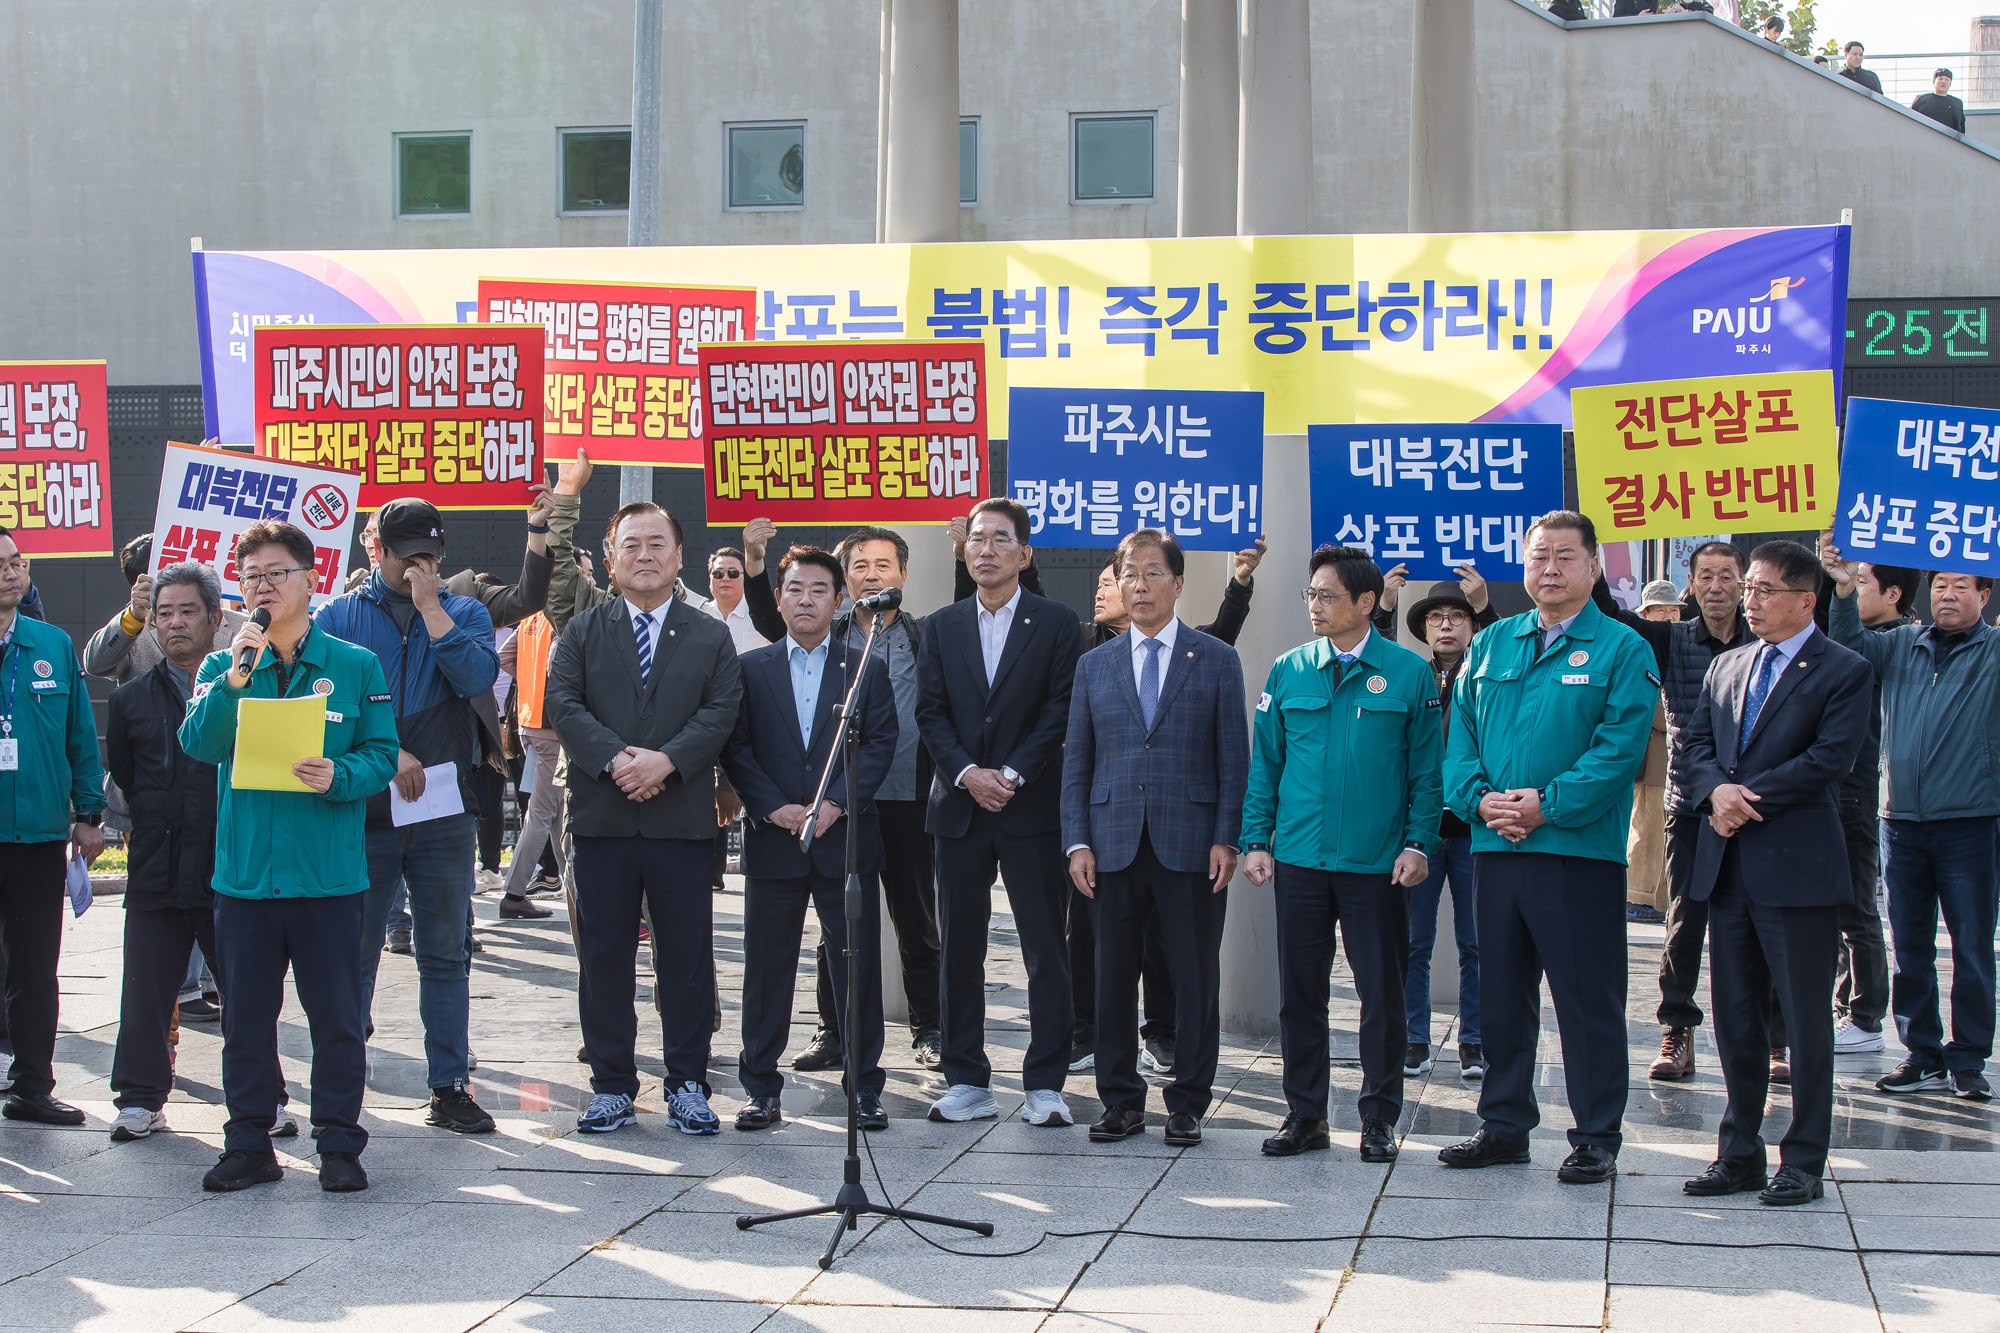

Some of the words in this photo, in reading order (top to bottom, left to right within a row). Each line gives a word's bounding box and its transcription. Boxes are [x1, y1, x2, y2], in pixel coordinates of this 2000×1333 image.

[605, 303, 672, 364] 평화를
[756, 290, 903, 340] 포는
[927, 286, 1071, 358] 불법!
[1100, 282, 1228, 357] 즉각
[1248, 279, 1554, 355] 중단하라!!
[1692, 306, 1772, 339] PAJU
[1735, 343, 1772, 355] 파주시
[272, 345, 400, 410] 파주시민의
[408, 345, 458, 408] 안전
[465, 345, 524, 409] 보장,
[591, 375, 638, 437] 살포
[643, 377, 702, 438] 중단
[709, 361, 837, 426] 탄현면민의
[842, 360, 919, 424] 안전권
[924, 360, 977, 423] 보장
[23, 382, 87, 450] 보장,
[1063, 403, 1212, 459] 파주시는
[1614, 389, 1799, 451] 전단살포
[375, 421, 426, 484] 살포
[433, 419, 535, 483] 중단하라
[713, 436, 815, 500] 대북전단
[820, 435, 872, 498] 살포
[877, 434, 980, 498] 중단하라
[1349, 437, 1529, 491] 대북전단
[0, 462, 101, 529] 중단하라
[177, 461, 298, 522] 대북전단
[308, 503, 328, 523] 전단
[324, 491, 343, 512] 대북
[1014, 478, 1123, 536] 평화를
[1132, 479, 1258, 537] 원한다!
[1604, 471, 1696, 528] 결사
[1705, 463, 1816, 521] 반대!
[1435, 514, 1540, 567] 반대
[1848, 492, 1917, 549] 살포
[1926, 500, 2000, 561] 중단
